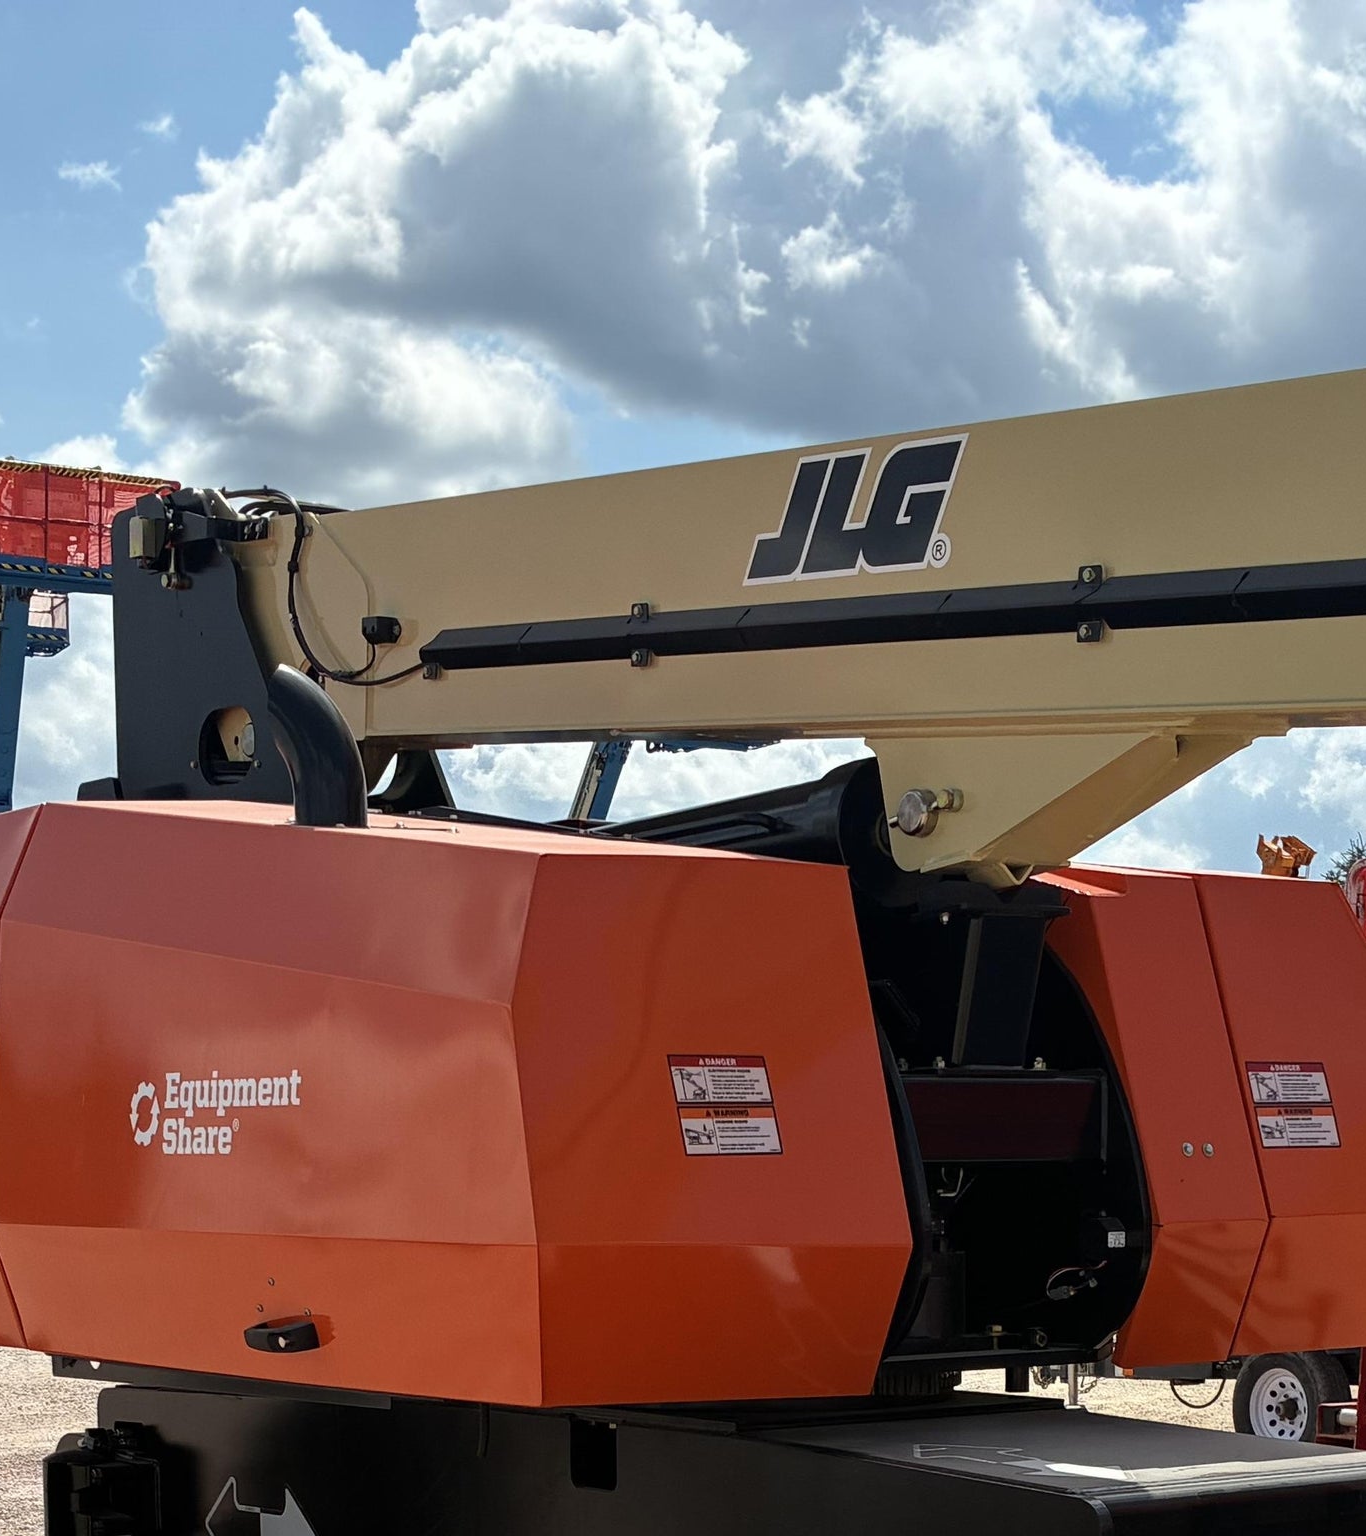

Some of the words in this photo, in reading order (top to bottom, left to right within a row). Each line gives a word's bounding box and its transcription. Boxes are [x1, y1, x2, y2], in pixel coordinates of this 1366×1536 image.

[742, 433, 969, 586] JLG
[706, 1058, 737, 1066] DANGER
[164, 1070, 301, 1117] Equipment
[713, 1109, 749, 1117] WARNING
[162, 1118, 233, 1155] Share
